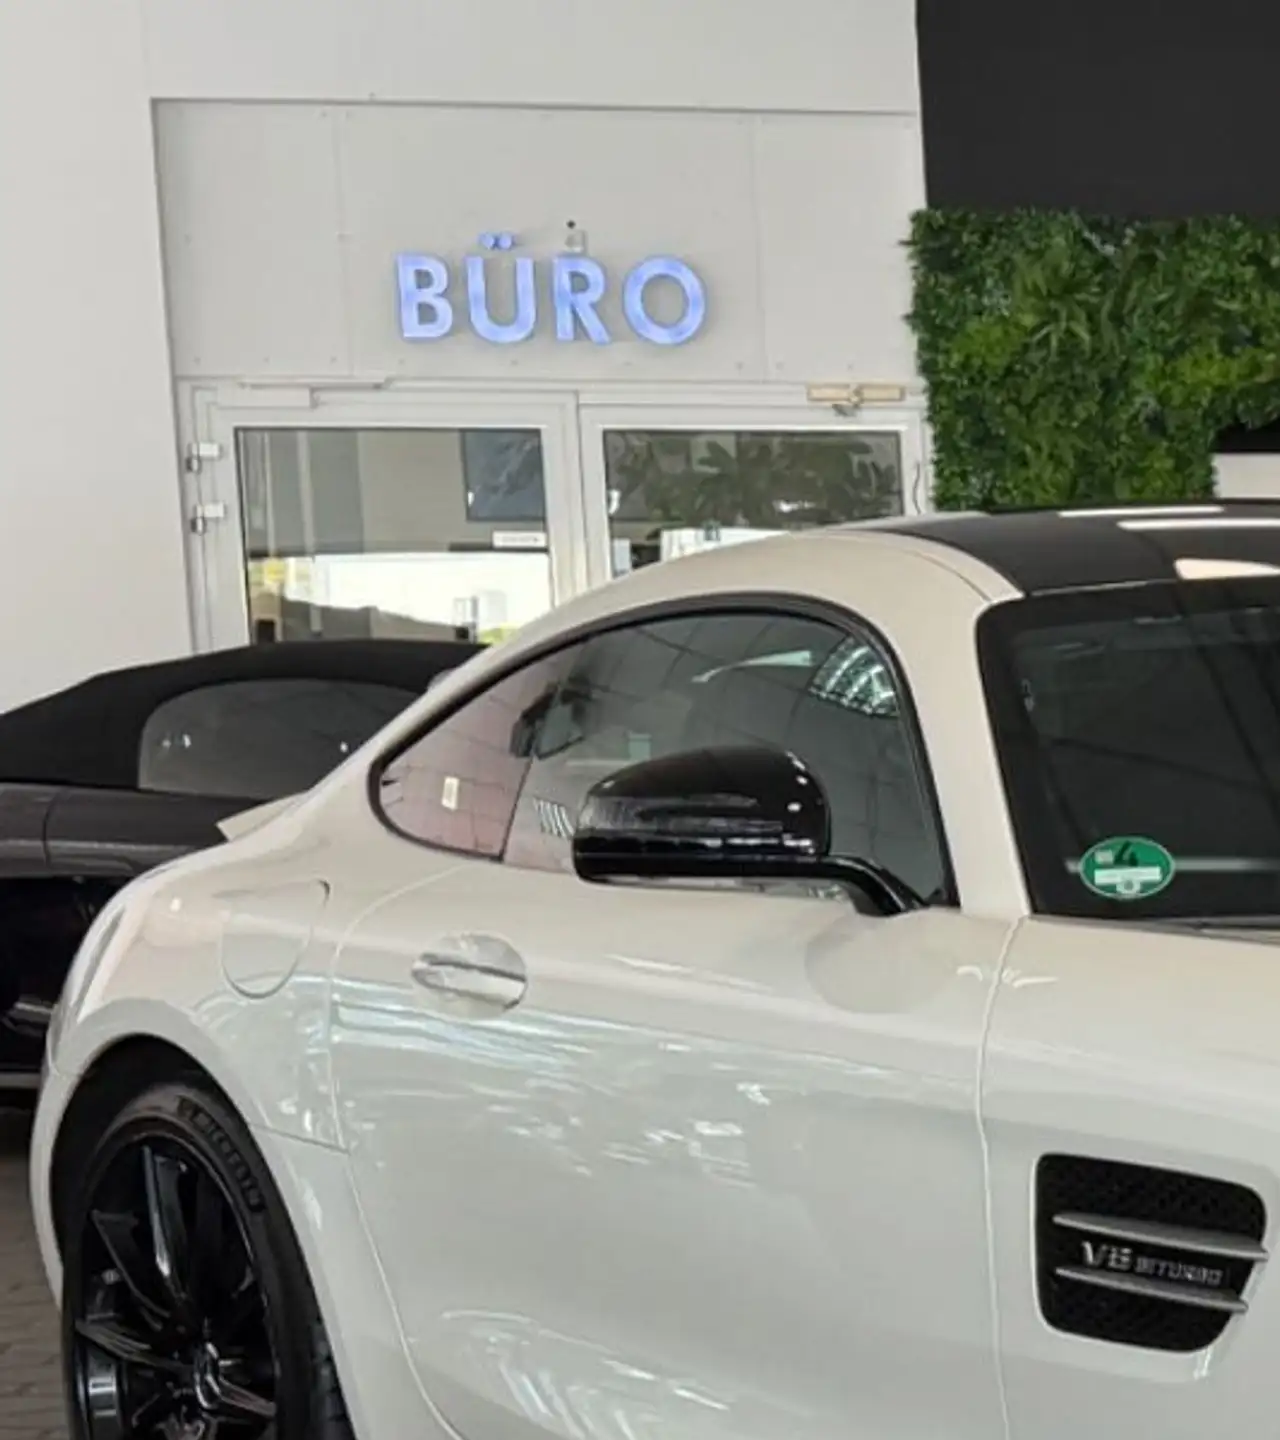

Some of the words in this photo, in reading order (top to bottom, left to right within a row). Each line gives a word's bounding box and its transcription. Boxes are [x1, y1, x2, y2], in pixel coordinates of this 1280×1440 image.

[396, 231, 707, 346] BÜRO
[1081, 1240, 1133, 1271] V8
[1135, 1255, 1224, 1287] BITURBO
